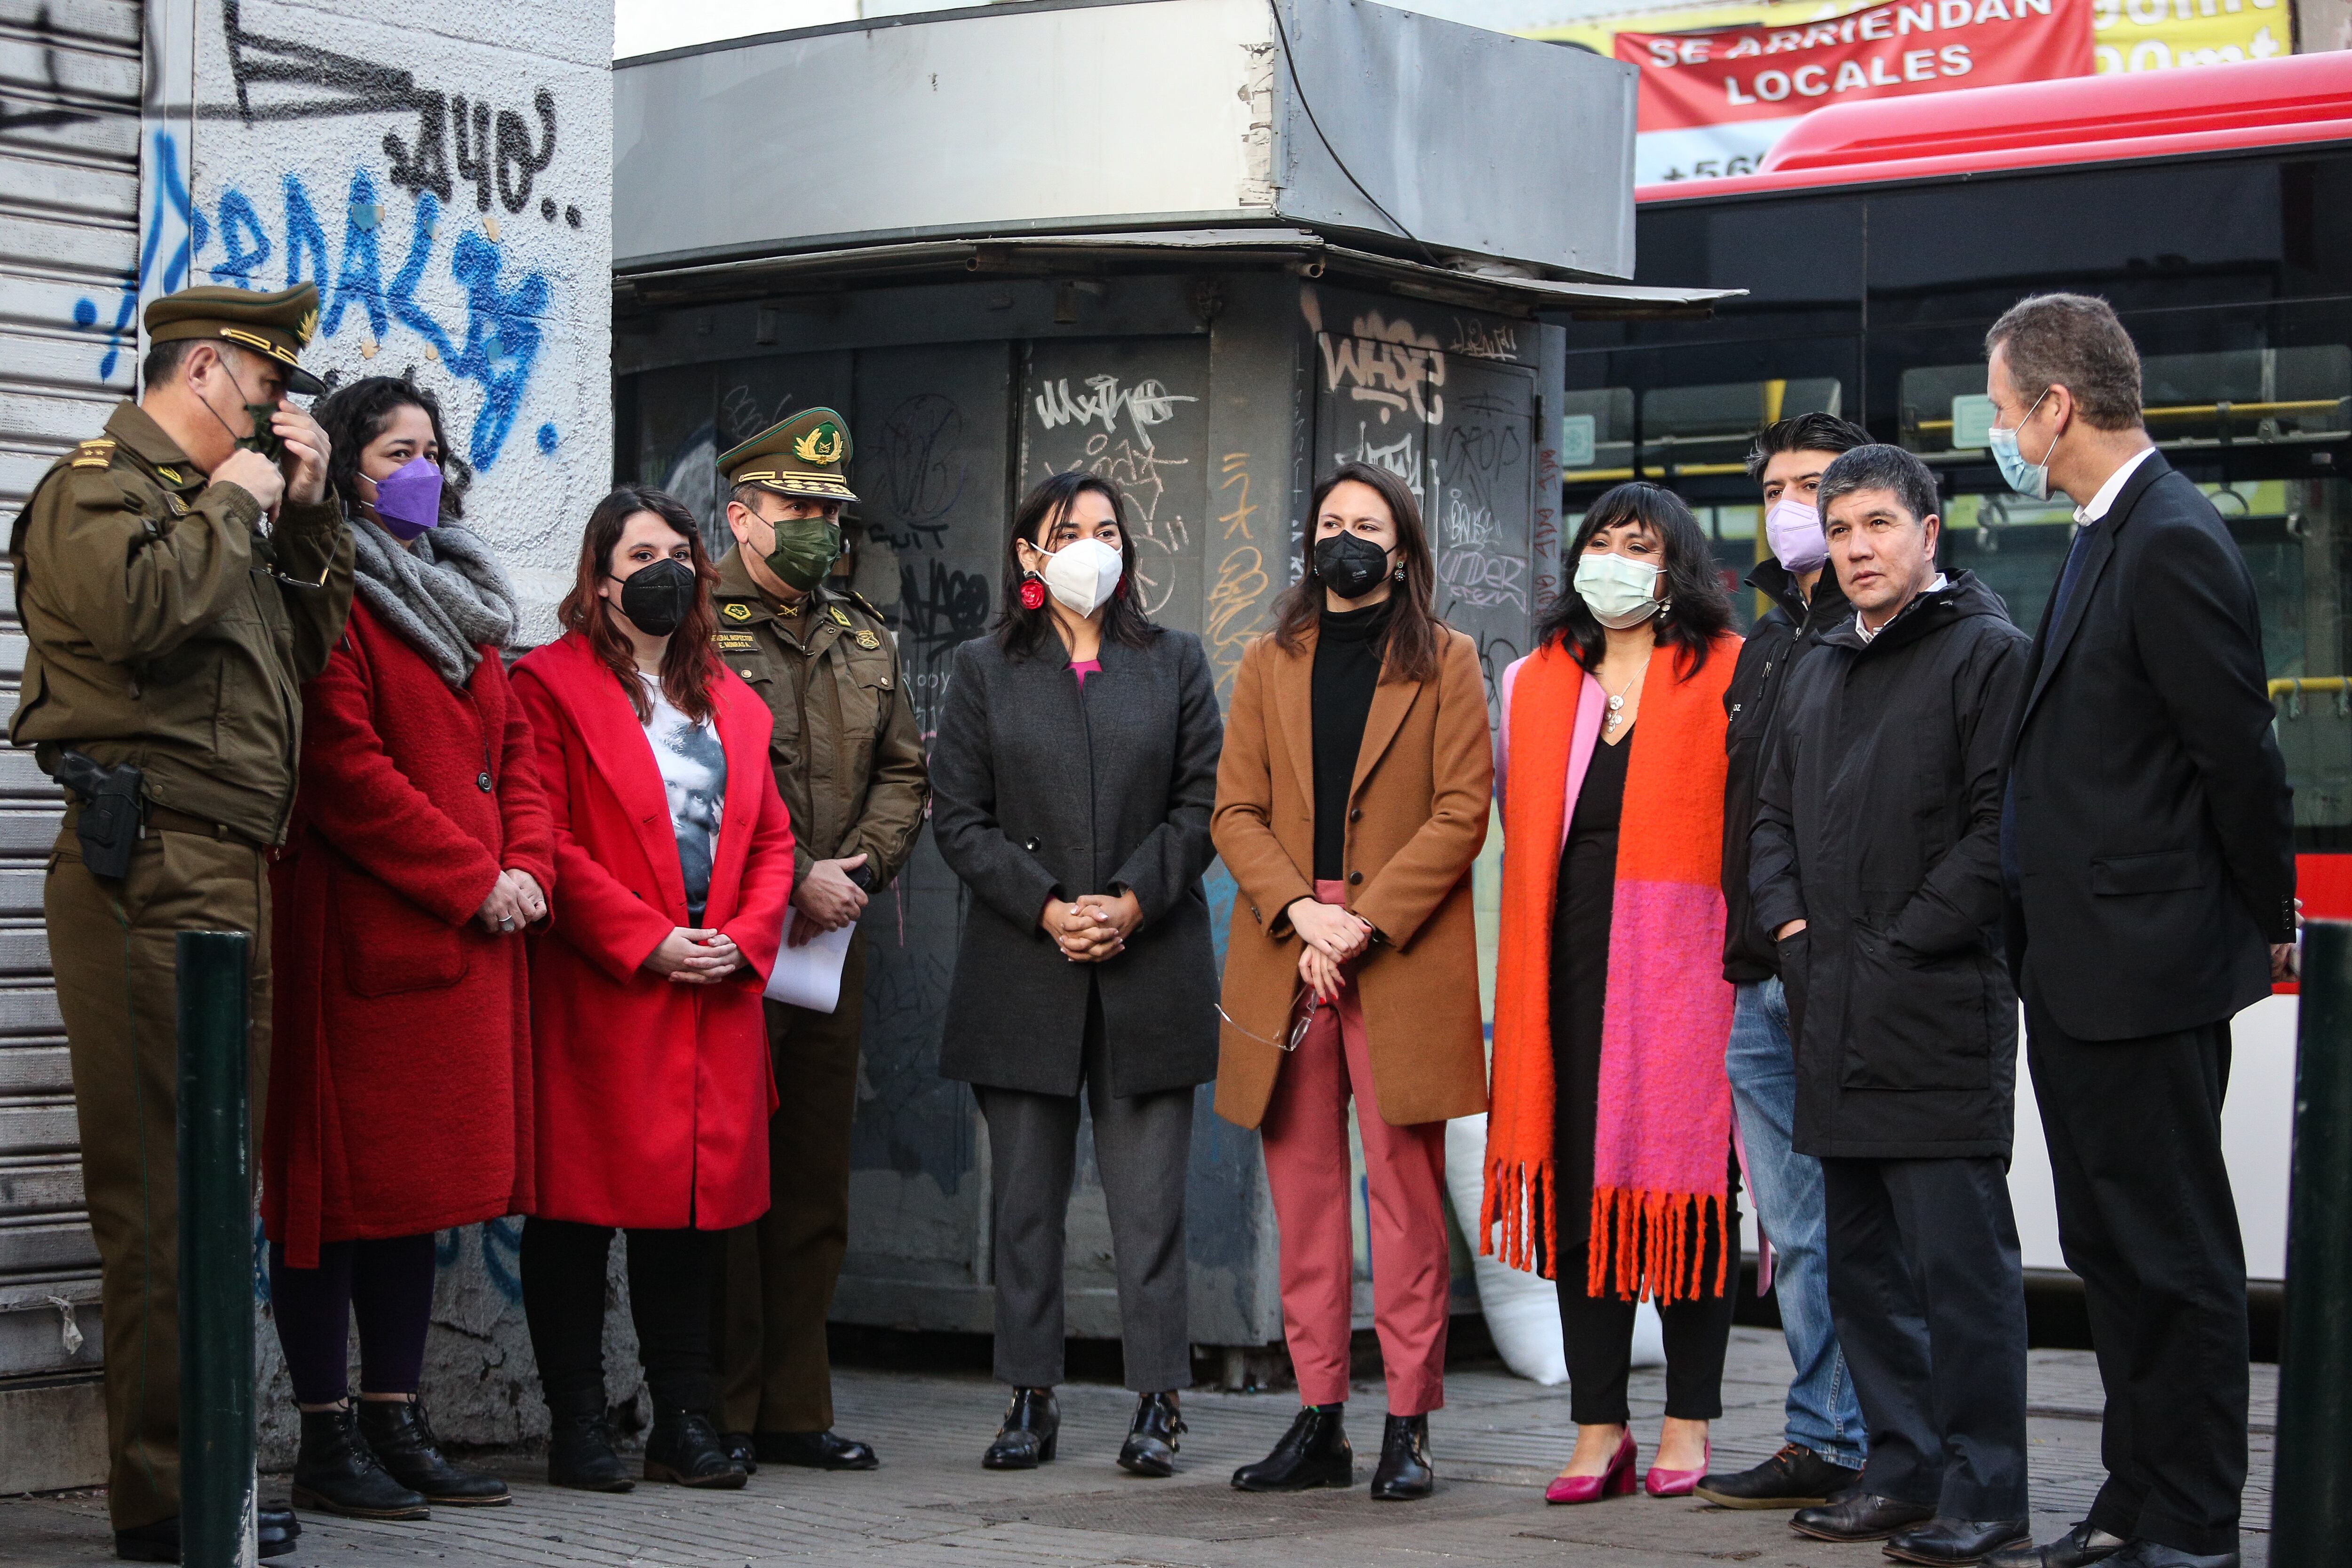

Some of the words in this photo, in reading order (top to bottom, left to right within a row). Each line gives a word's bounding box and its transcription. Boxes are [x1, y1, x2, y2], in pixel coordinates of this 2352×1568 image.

[1648, 39, 1713, 68] SE
[1724, 0, 2052, 60] ARRIENDAN
[1724, 43, 1974, 106] LOCALES
